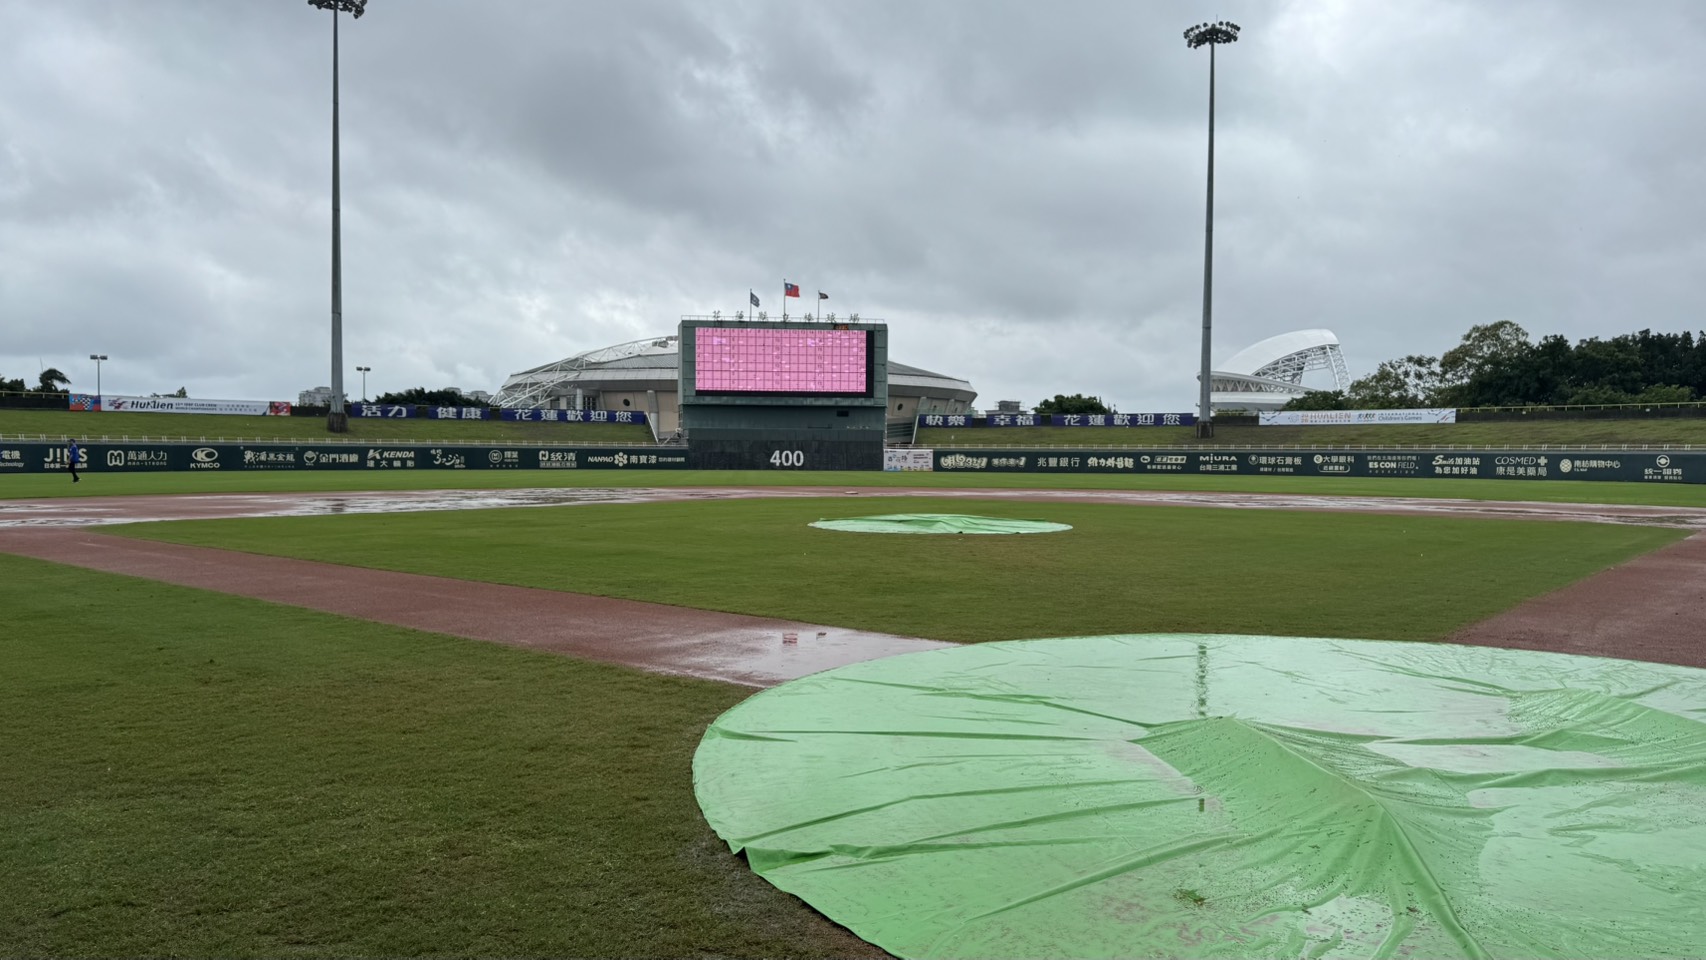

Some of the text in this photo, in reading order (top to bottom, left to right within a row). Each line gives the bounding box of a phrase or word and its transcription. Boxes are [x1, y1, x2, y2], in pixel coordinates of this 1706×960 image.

[361, 405, 407, 418] 活力
[436, 406, 482, 419] 健康
[514, 409, 632, 422] 花蓮歡迎您
[926, 415, 966, 426] 快樂
[993, 415, 1034, 426] 幸福
[1063, 413, 1180, 426] 花蓮歡迎您
[127, 450, 167, 460] 萬通人力
[319, 453, 359, 463] 金門酒廠
[550, 452, 576, 461] 統清
[629, 455, 657, 464] 南寶漆
[770, 450, 804, 467] 400
[1323, 455, 1355, 464] 大學眼科
[1037, 457, 1080, 467] 兆豐銀行
[1259, 456, 1302, 465] 環球石膏板
[1380, 461, 1397, 469] CON
[1455, 456, 1481, 466] 加油站
[1495, 456, 1537, 465] COSMED
[1435, 466, 1478, 475] 為您加好油
[1496, 466, 1548, 477] 康是美藥局
